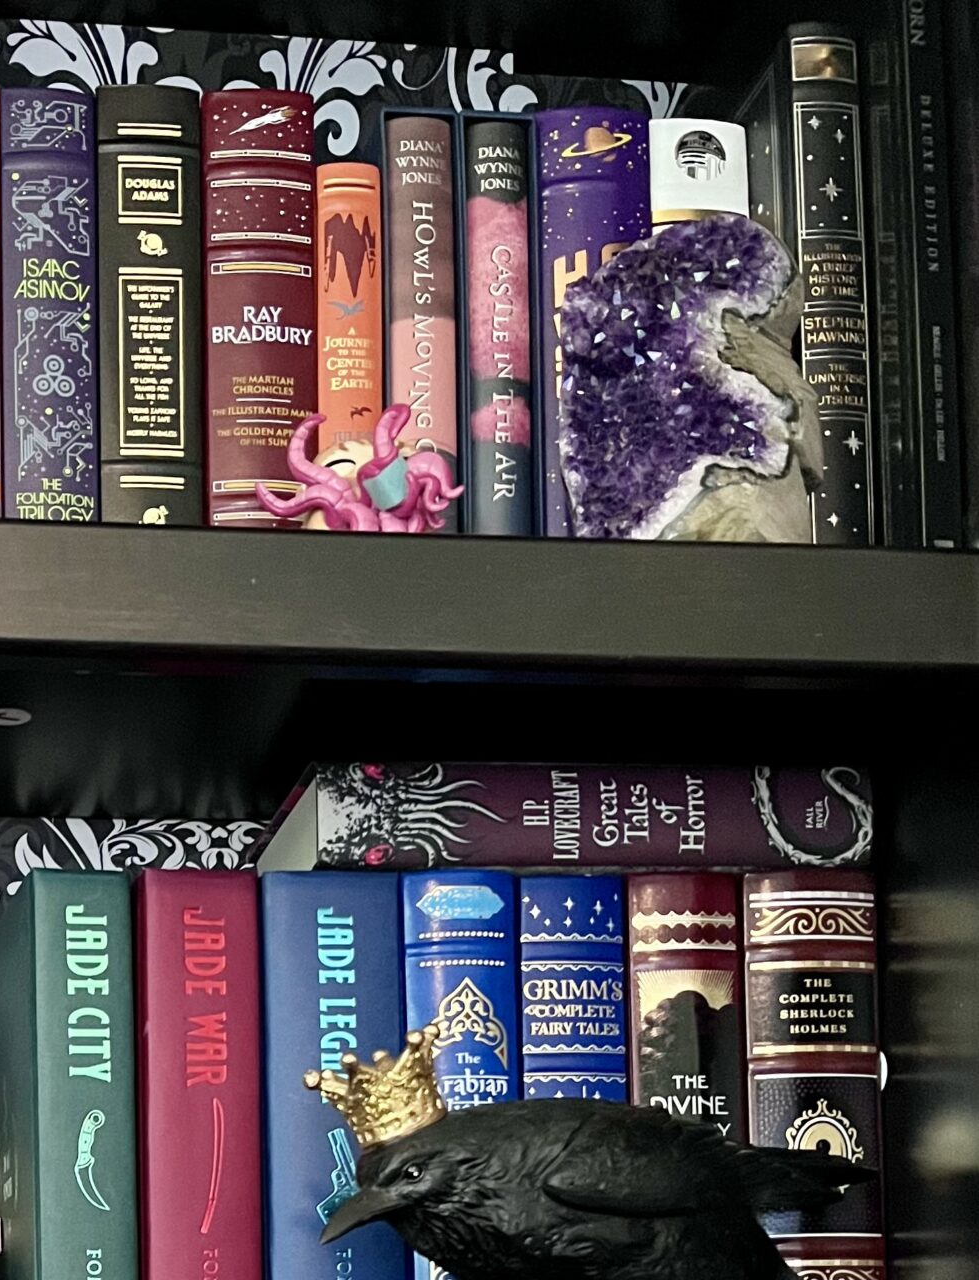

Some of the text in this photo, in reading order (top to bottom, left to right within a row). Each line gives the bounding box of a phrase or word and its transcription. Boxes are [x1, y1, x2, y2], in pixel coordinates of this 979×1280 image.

[399, 140, 442, 154] DIANA
[125, 178, 175, 190] DOUGLAS
[401, 171, 442, 186] JONES
[132, 190, 169, 202] ADAMS
[412, 200, 436, 305] HOWL'S
[23, 258, 81, 280] ISAAC
[811, 263, 820, 272] A
[809, 275, 858, 285] HISTORY
[13, 280, 91, 302] ASIMOV
[811, 286, 859, 297] OF TIME
[243, 306, 283, 325] RAY
[804, 317, 866, 330] STEPHEN
[212, 325, 313, 346] BRADBURY
[348, 327, 357, 336] A
[807, 332, 865, 343] HAWKING
[409, 314, 435, 429] MOVING
[489, 244, 515, 502] CASTLE IN THE AIR
[248, 375, 294, 385] MARTIAN
[809, 374, 866, 384] UNIVERSE
[233, 386, 294, 396] CHRONICLES
[228, 406, 289, 416] ILLUSTRATED
[233, 427, 274, 437] GOLDEN
[268, 437, 288, 447] SUN
[41, 478, 62, 491] THE
[16, 492, 94, 508] FOUNDATION
[551, 770, 581, 860] LOVECRAFT
[593, 777, 620, 848] Great
[622, 783, 650, 845] Tales
[678, 774, 706, 855] Horror
[317, 906, 356, 984] JADE
[523, 978, 623, 1001] GRIMM'S
[804, 978, 832, 988] THE
[65, 904, 111, 1083] JADE CITY
[183, 906, 228, 1088] JADE WAR
[779, 994, 854, 1004] COMPLETE
[779, 1009, 855, 1020] SHERLOCK
[531, 1022, 620, 1036] FAIRY TALES
[790, 1024, 847, 1035] HOLMES
[455, 1052, 481, 1065] The
[672, 1075, 709, 1090] THE
